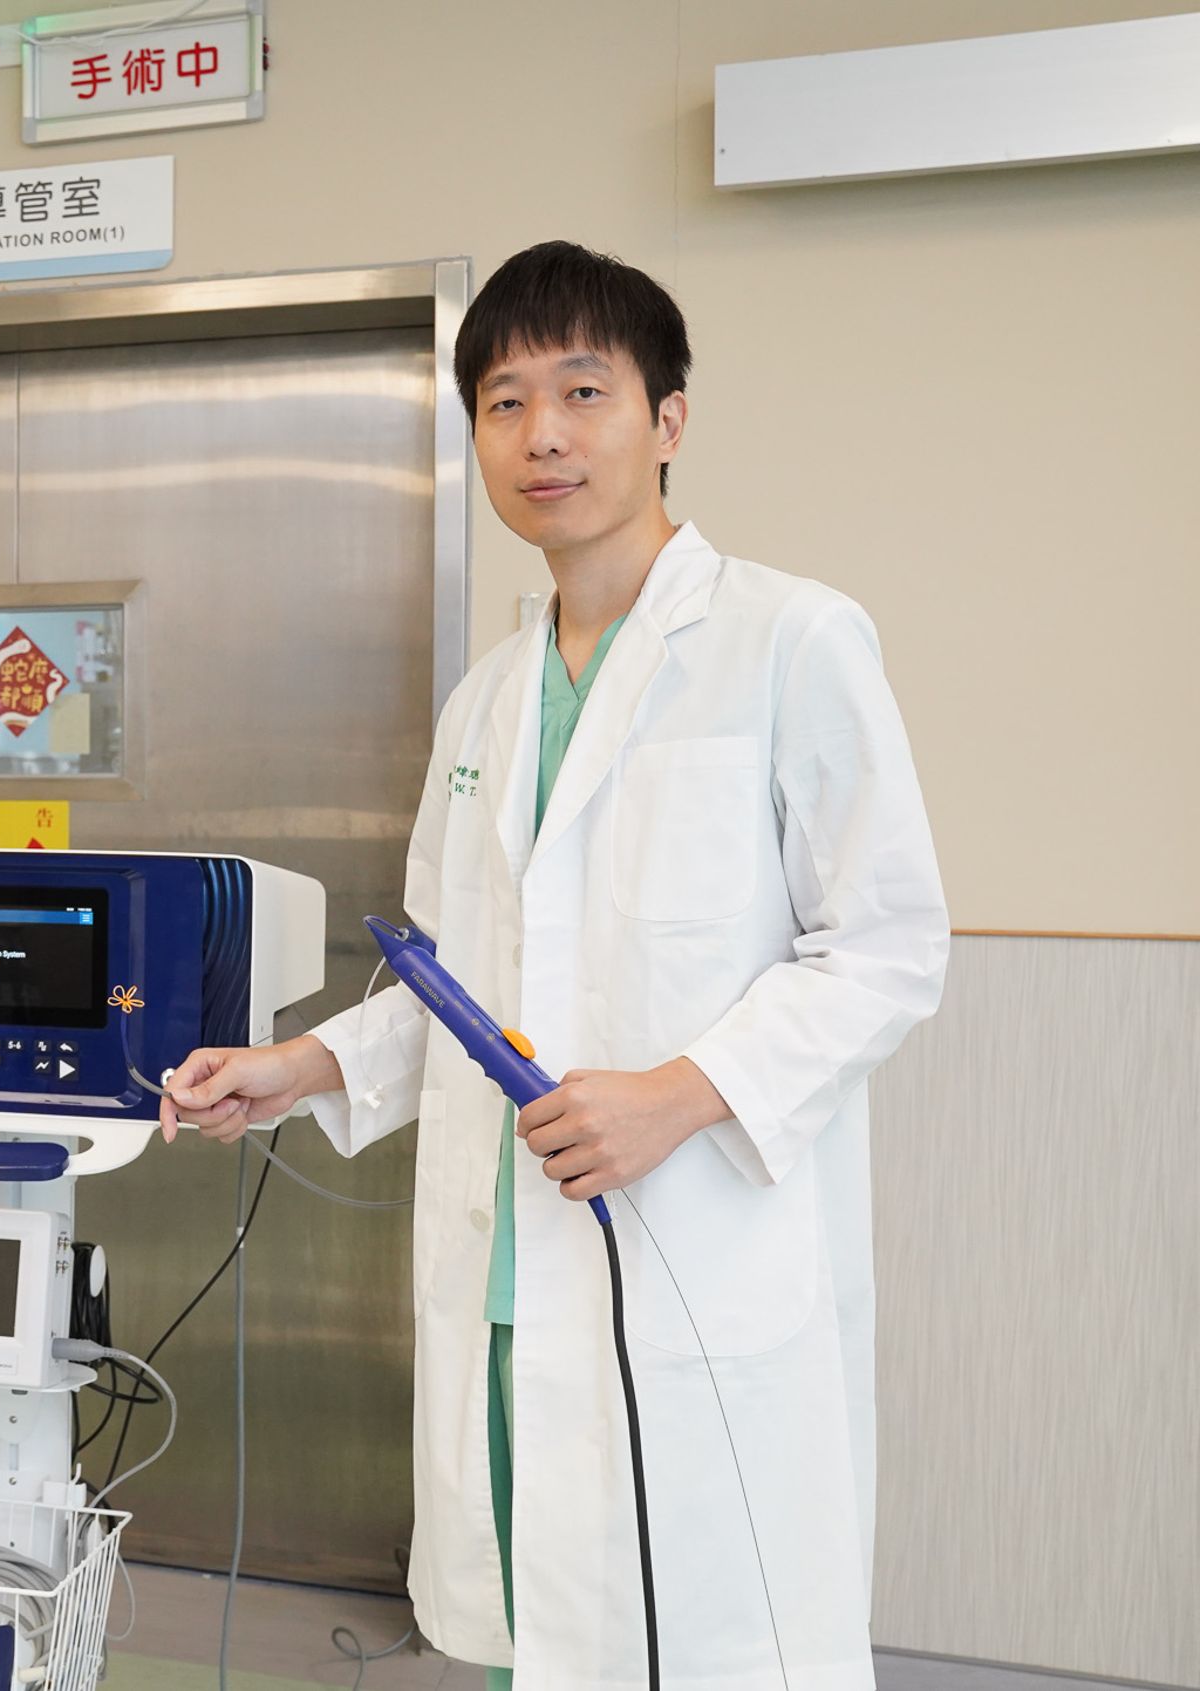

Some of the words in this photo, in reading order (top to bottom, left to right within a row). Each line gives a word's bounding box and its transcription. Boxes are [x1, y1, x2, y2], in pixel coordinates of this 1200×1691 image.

[70, 41, 218, 100] 手術中
[50, 225, 125, 245] ROOM(1)
[3, 950, 26, 959] System
[411, 970, 445, 1008] FARAWAVE
[8, 1041, 22, 1049] 5-6
